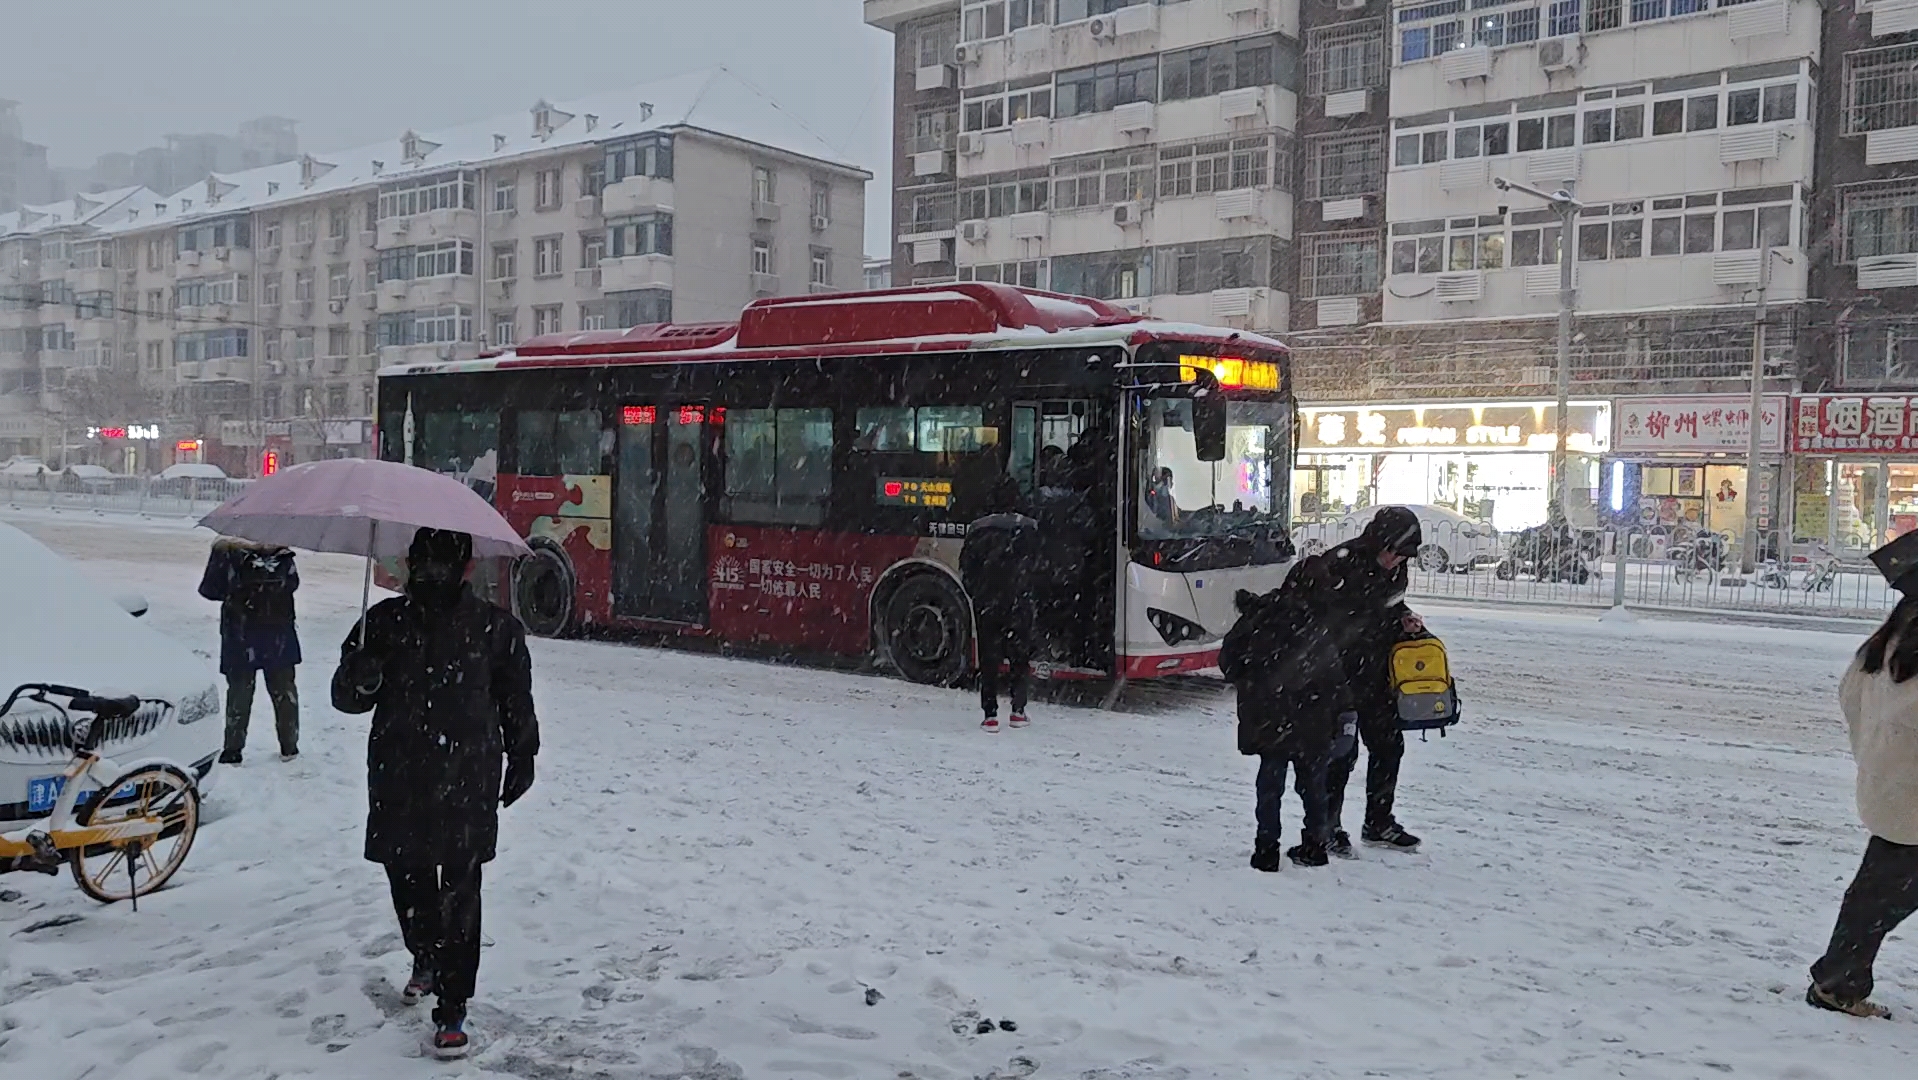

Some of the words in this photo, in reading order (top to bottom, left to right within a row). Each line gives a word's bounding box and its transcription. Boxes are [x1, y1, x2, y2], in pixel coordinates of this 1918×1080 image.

[1466, 425, 1521, 444] STYLE
[715, 567, 739, 582] 415
[750, 558, 873, 583] 国家安全一切为了人民
[749, 577, 821, 599] 一切依靠人民
